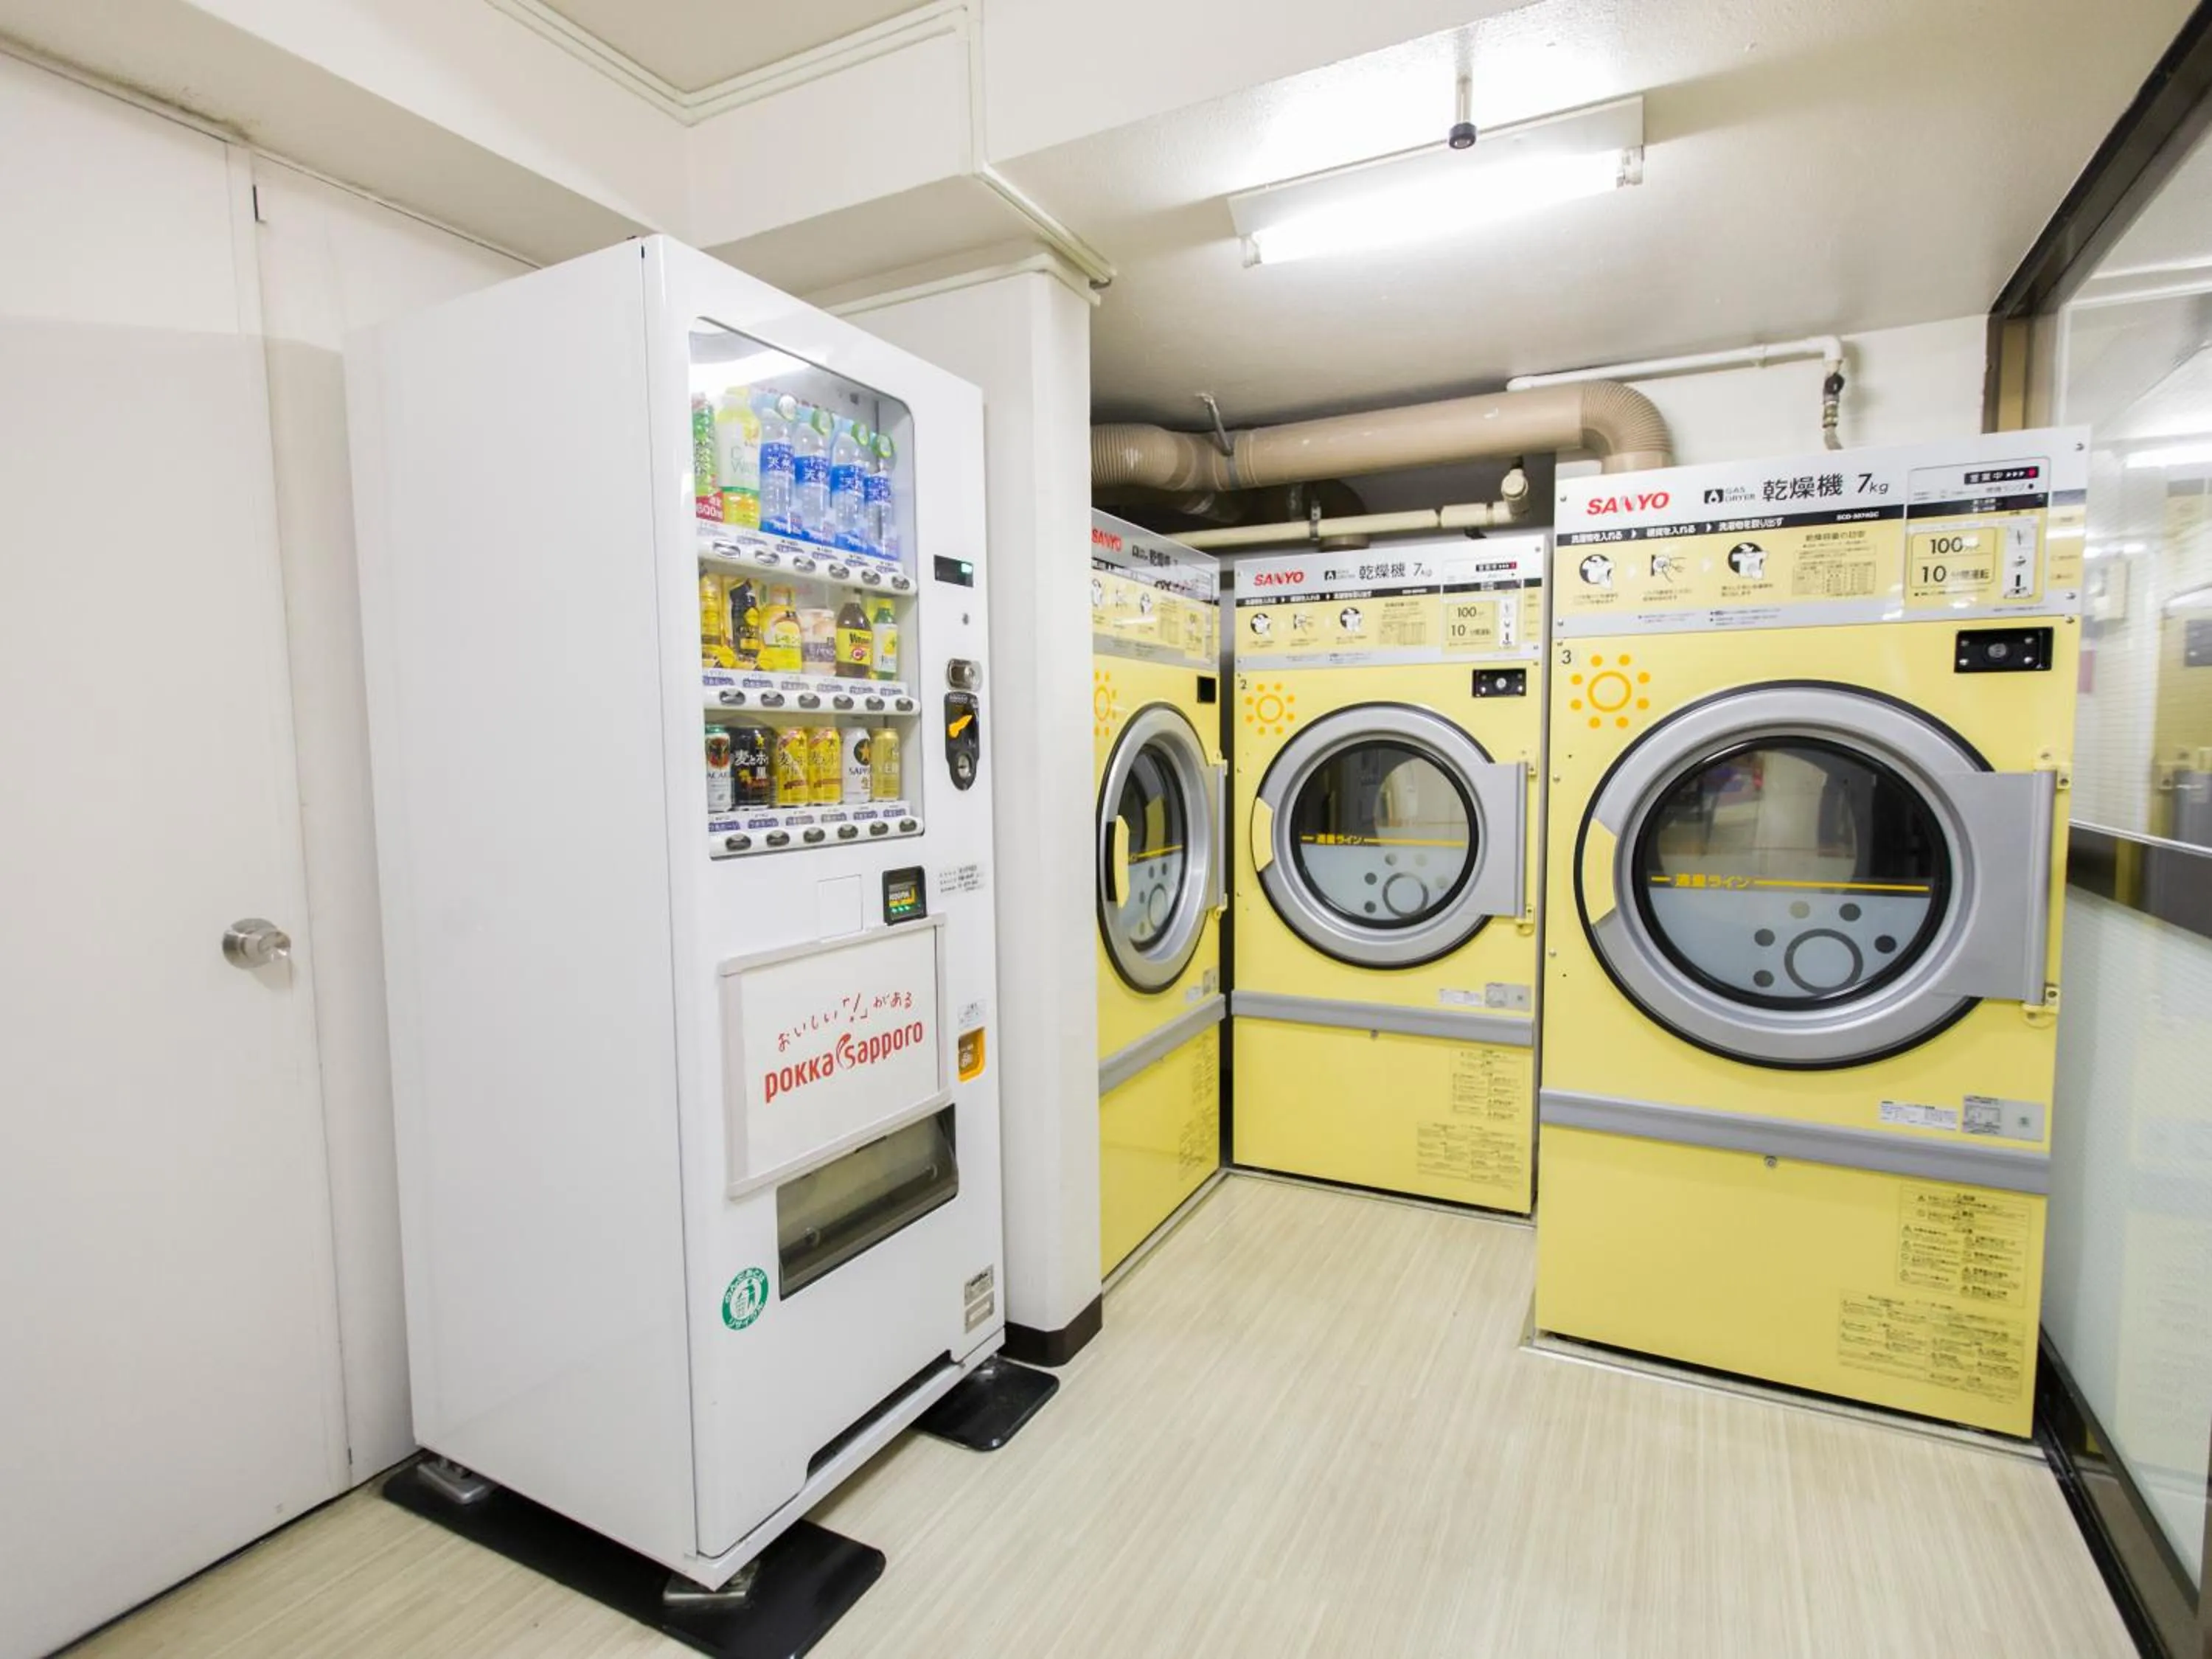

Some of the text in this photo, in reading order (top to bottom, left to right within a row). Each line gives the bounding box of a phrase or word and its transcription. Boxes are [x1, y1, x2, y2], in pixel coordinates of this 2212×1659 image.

[1762, 473, 1843, 502] 乾燥機
[1586, 492, 1669, 515] SANYO
[1253, 571, 1304, 587] SANYO
[1358, 562, 1406, 580] 乾燥機
[1562, 650, 1572, 664] 3
[1240, 679, 1248, 690] 2
